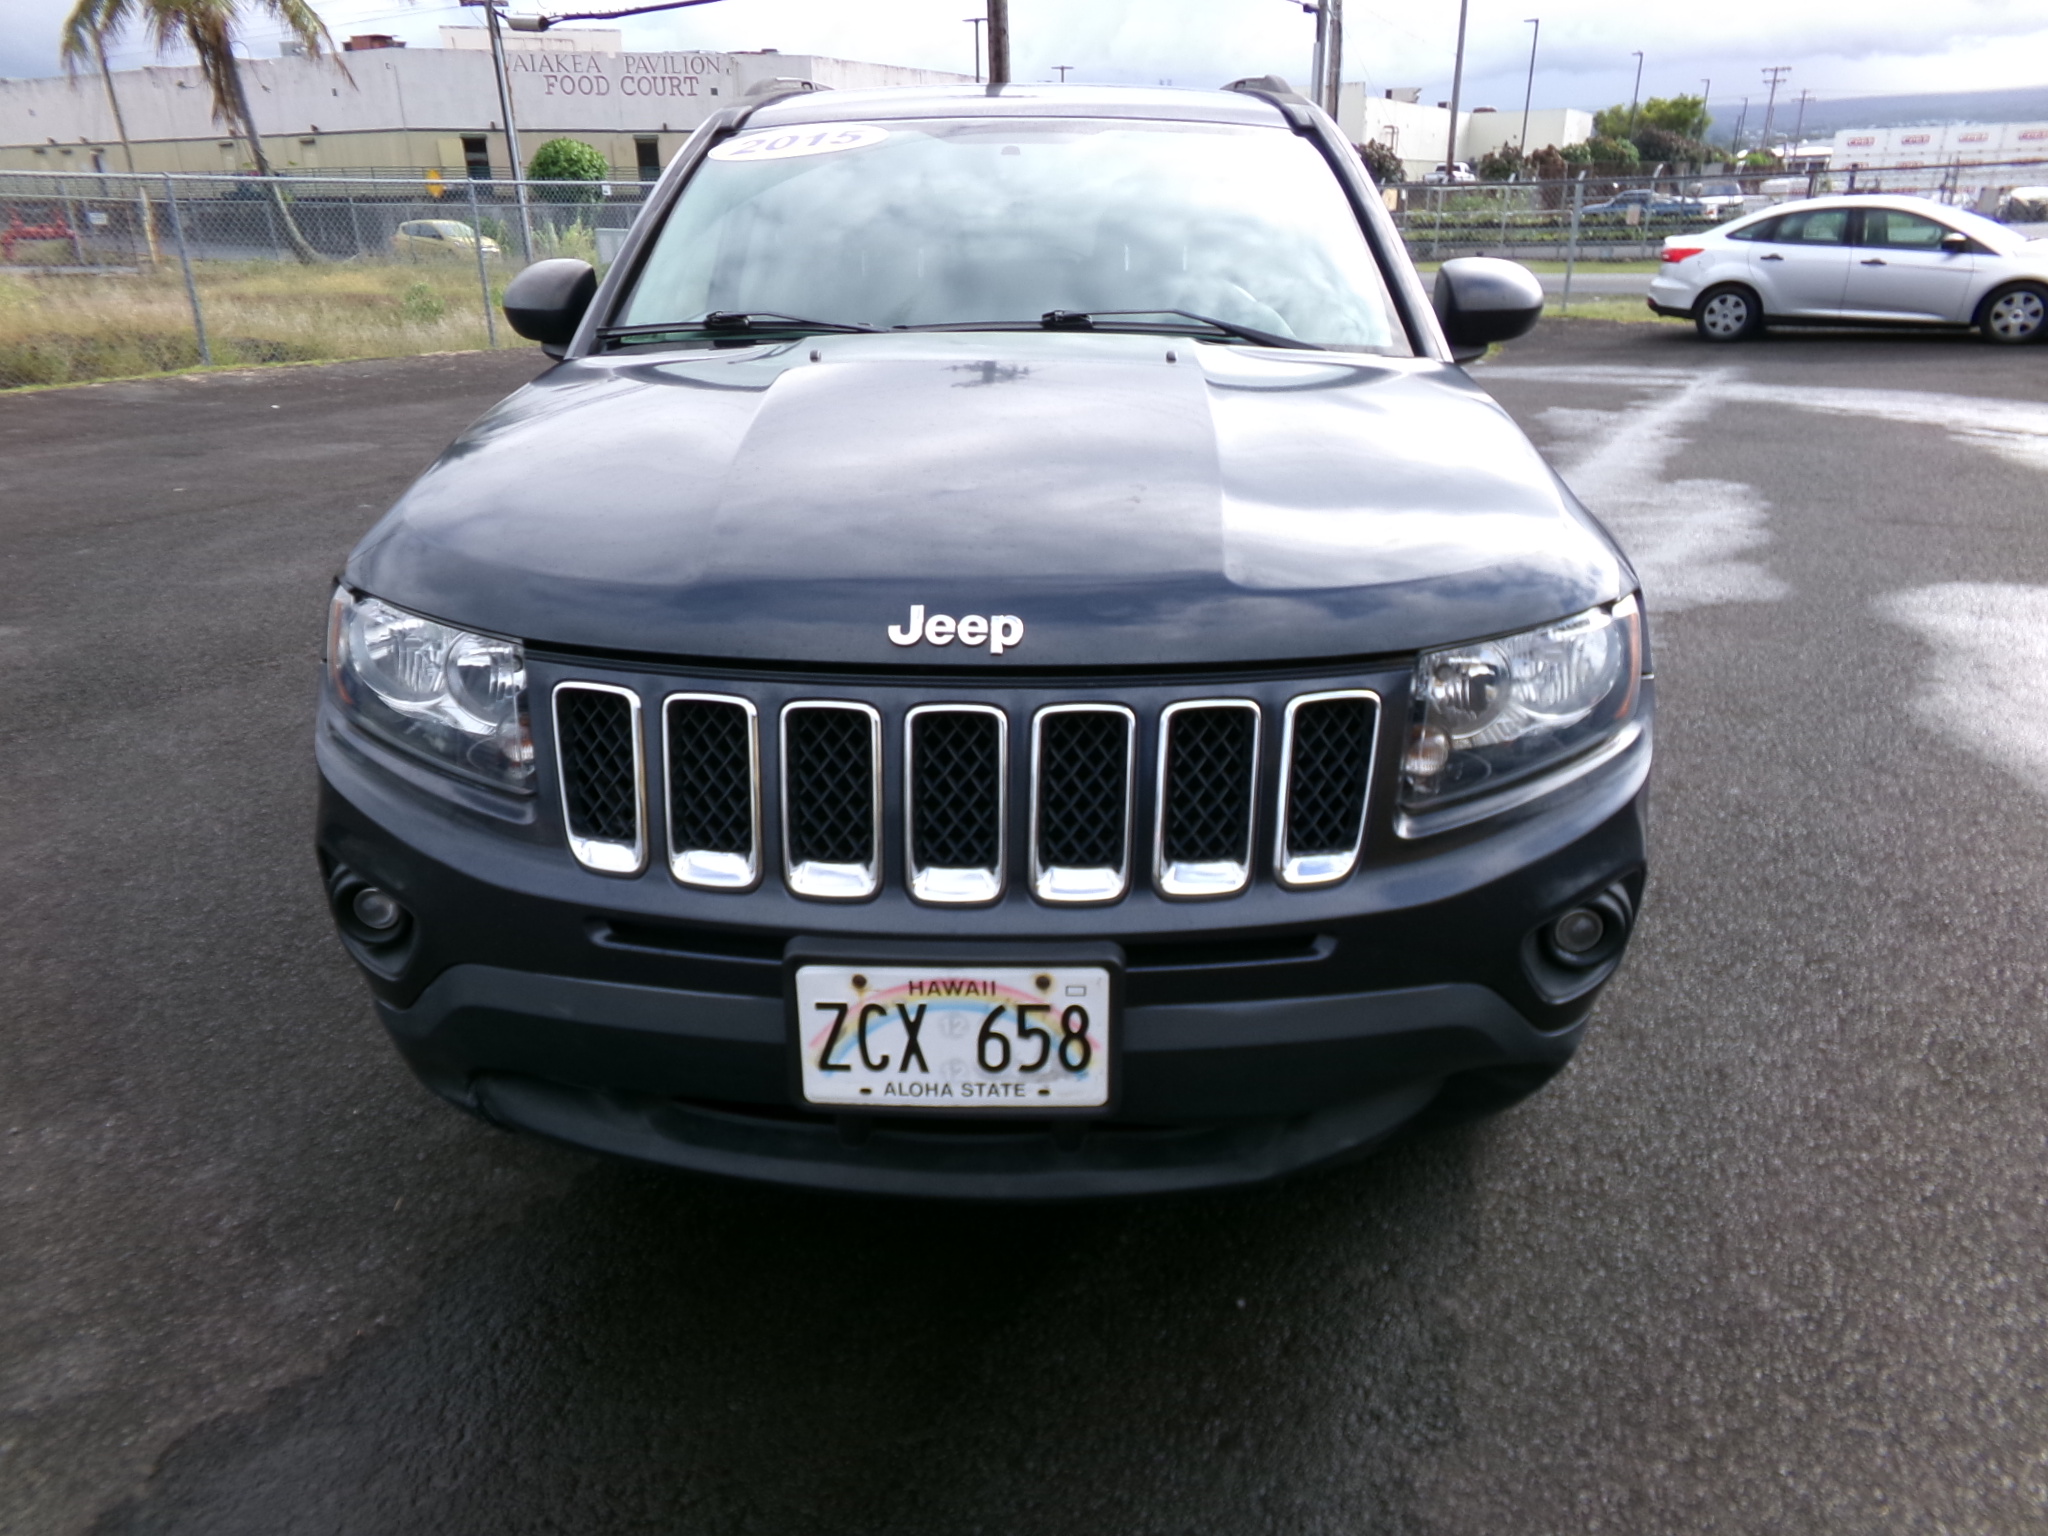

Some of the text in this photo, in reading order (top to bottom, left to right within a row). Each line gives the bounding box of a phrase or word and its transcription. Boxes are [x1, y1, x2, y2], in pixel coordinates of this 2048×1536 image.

[507, 53, 721, 75] AIAKEA PAVILION
[543, 75, 699, 97] FOOD COURT
[729, 130, 868, 156] 2015
[887, 604, 1024, 655] Jeep
[908, 980, 997, 997] HAWAII
[815, 1003, 1092, 1073] ZCX 658
[884, 1082, 1026, 1098] ALOHA STATE
